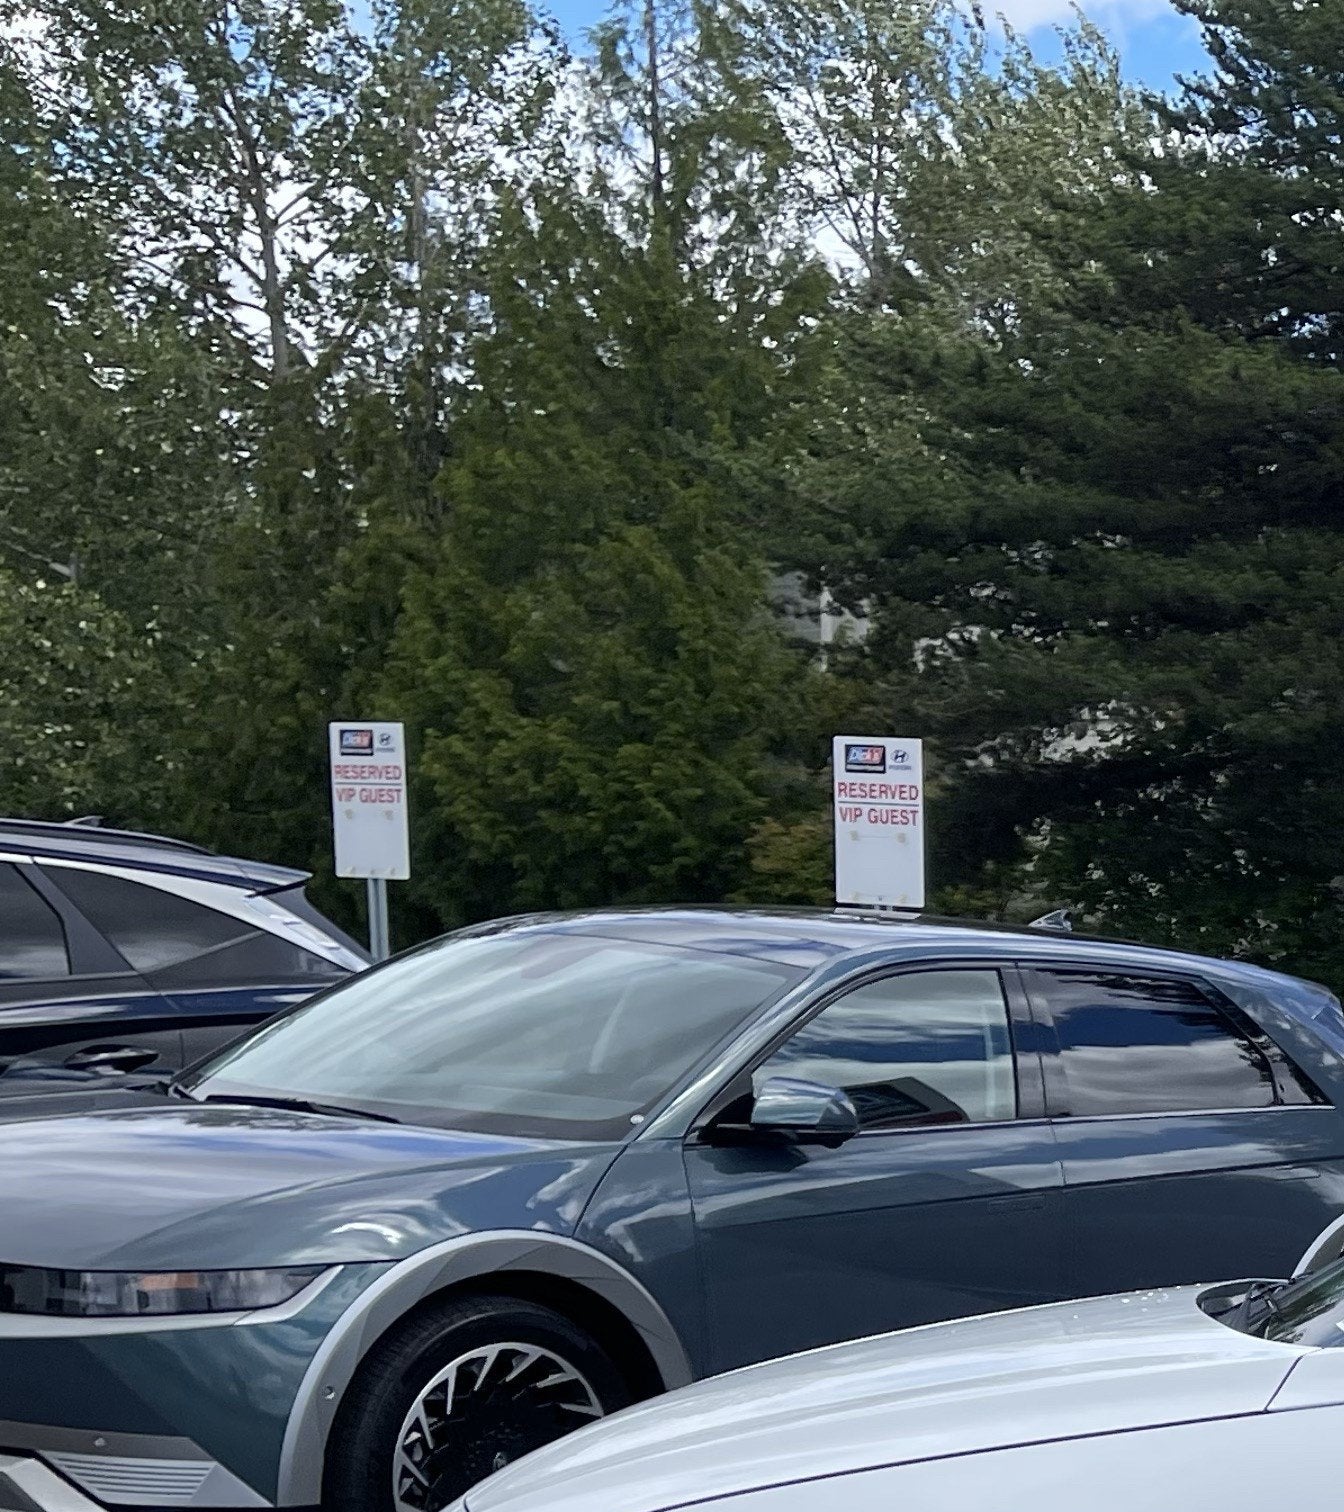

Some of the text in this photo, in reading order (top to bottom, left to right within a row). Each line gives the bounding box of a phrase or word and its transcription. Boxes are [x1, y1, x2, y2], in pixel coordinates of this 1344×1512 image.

[334, 764, 402, 781] RESERVED
[335, 787, 402, 803] VIP GUEST
[837, 781, 920, 801] RESERVED
[839, 806, 919, 826] VIP GUEST
